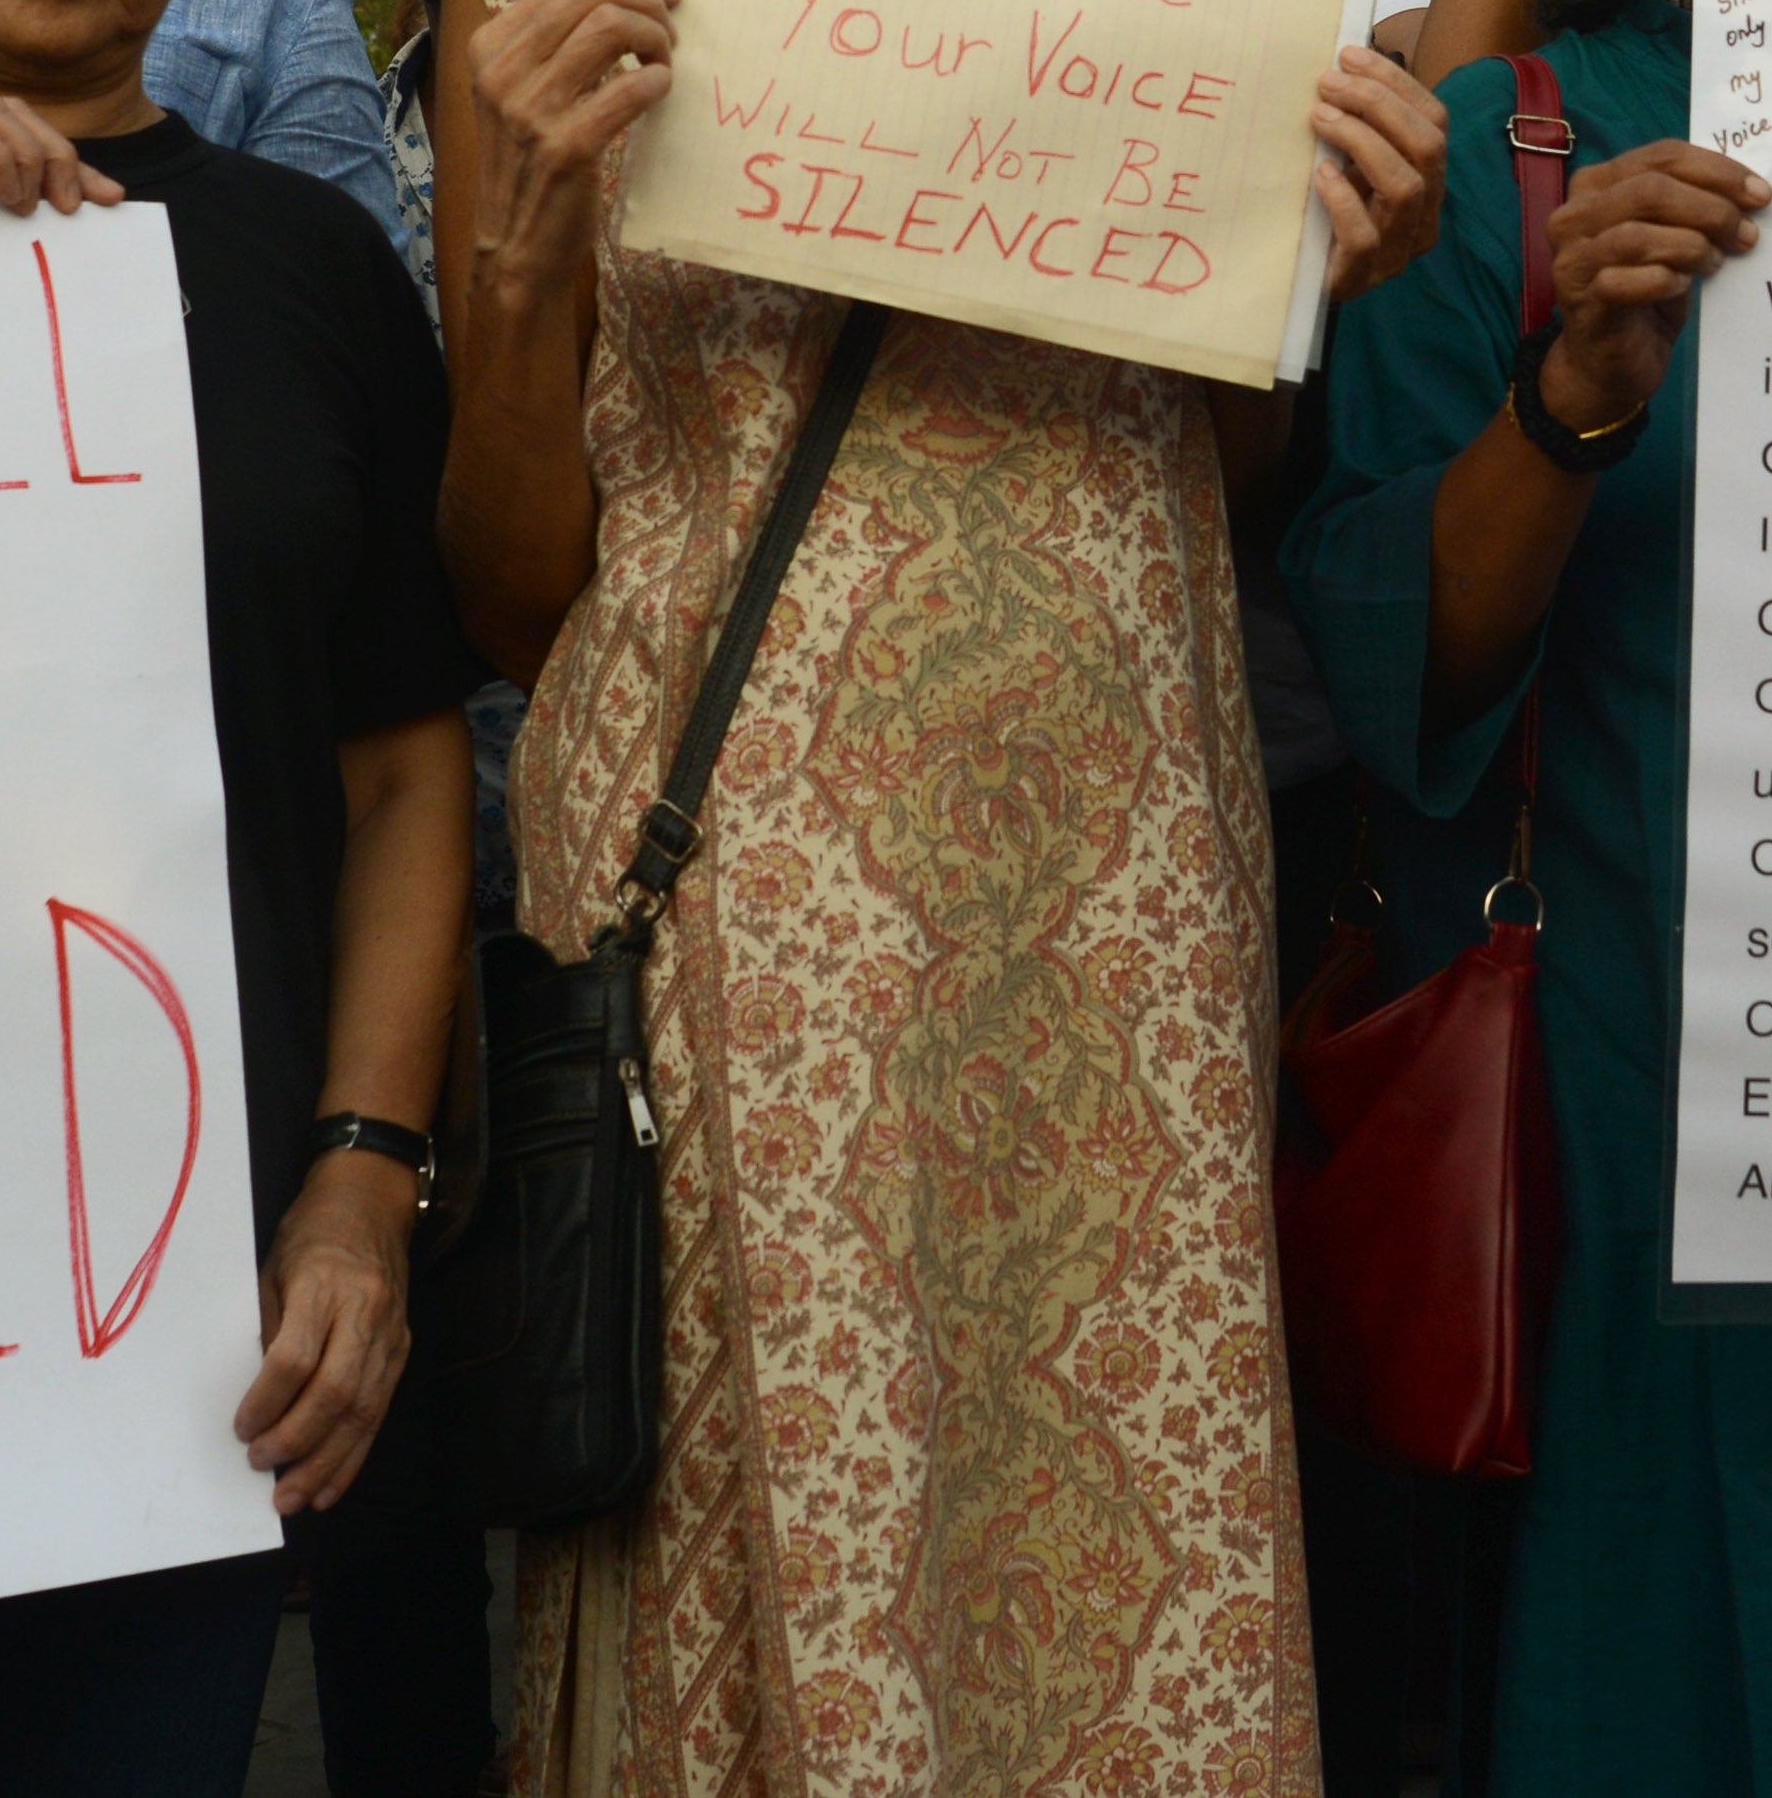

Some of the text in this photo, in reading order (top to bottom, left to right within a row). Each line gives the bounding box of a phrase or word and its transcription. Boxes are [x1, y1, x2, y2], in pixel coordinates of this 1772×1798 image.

[1727, 14, 1765, 47] only
[1730, 71, 1762, 104] my
[714, 76, 920, 158] WILL
[1103, 139, 1205, 213] BE
[736, 153, 1212, 295] SILENCED
